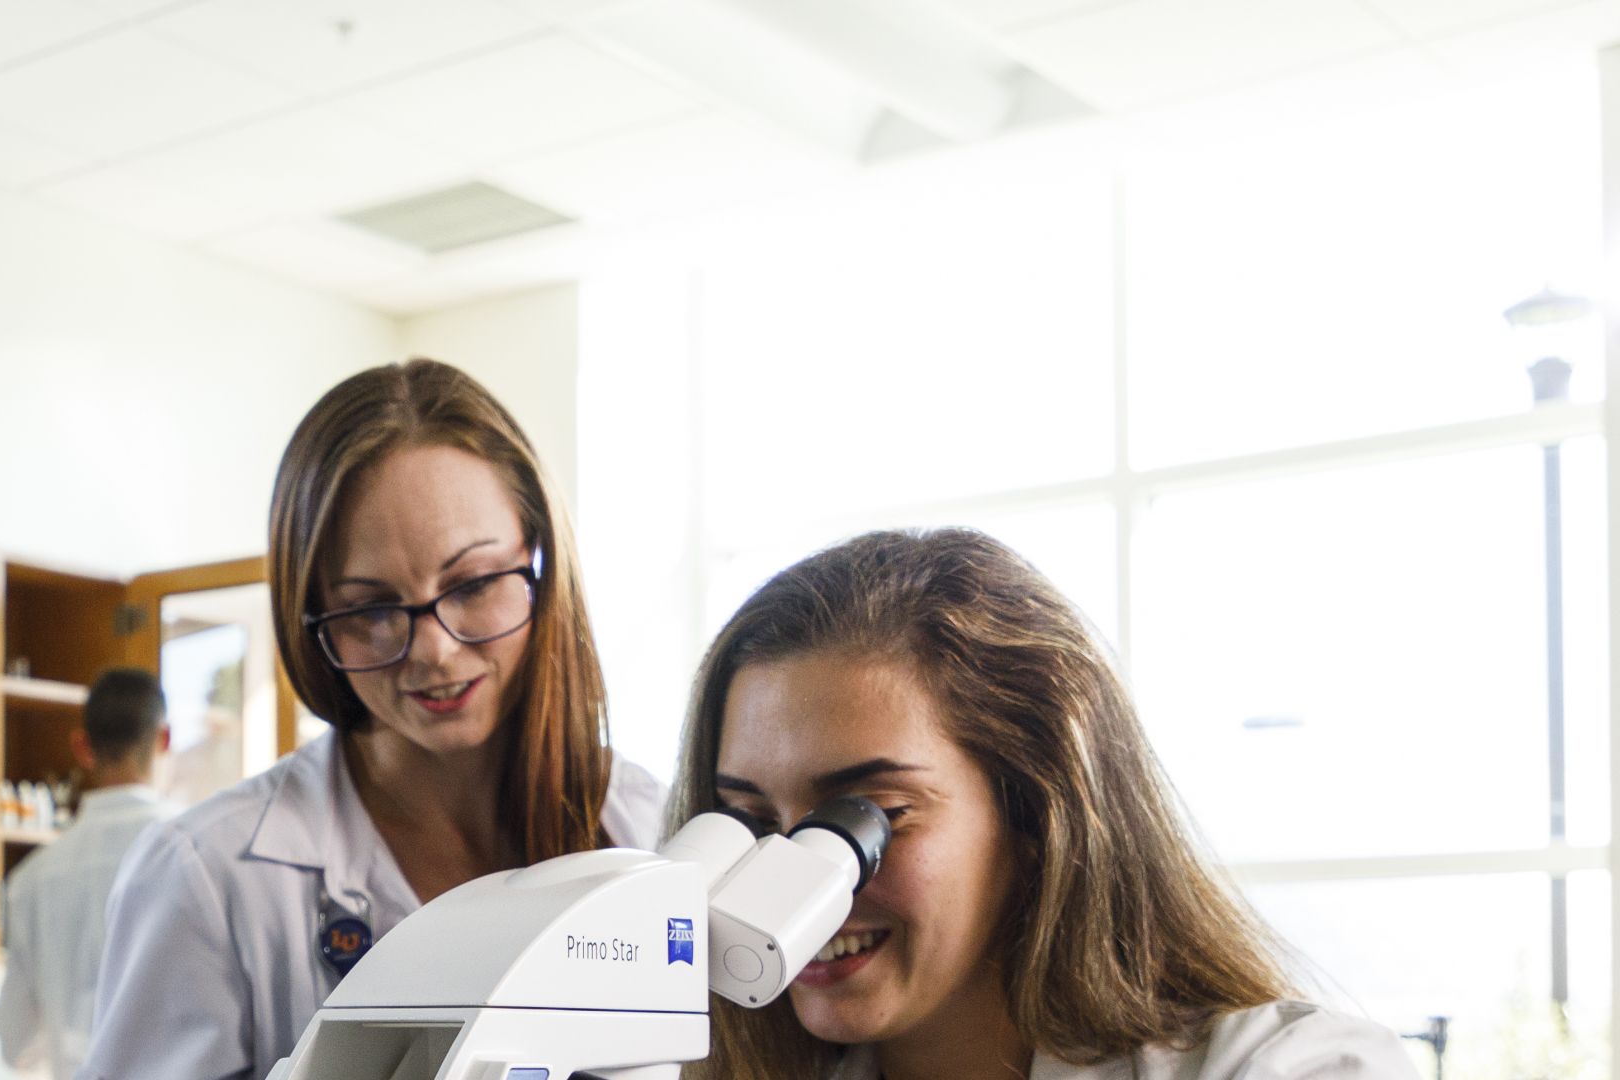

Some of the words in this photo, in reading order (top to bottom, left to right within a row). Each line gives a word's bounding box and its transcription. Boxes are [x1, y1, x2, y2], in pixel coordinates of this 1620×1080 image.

[668, 929, 693, 941] ZEISS
[567, 935, 607, 960] Primo
[612, 938, 639, 962] Star
